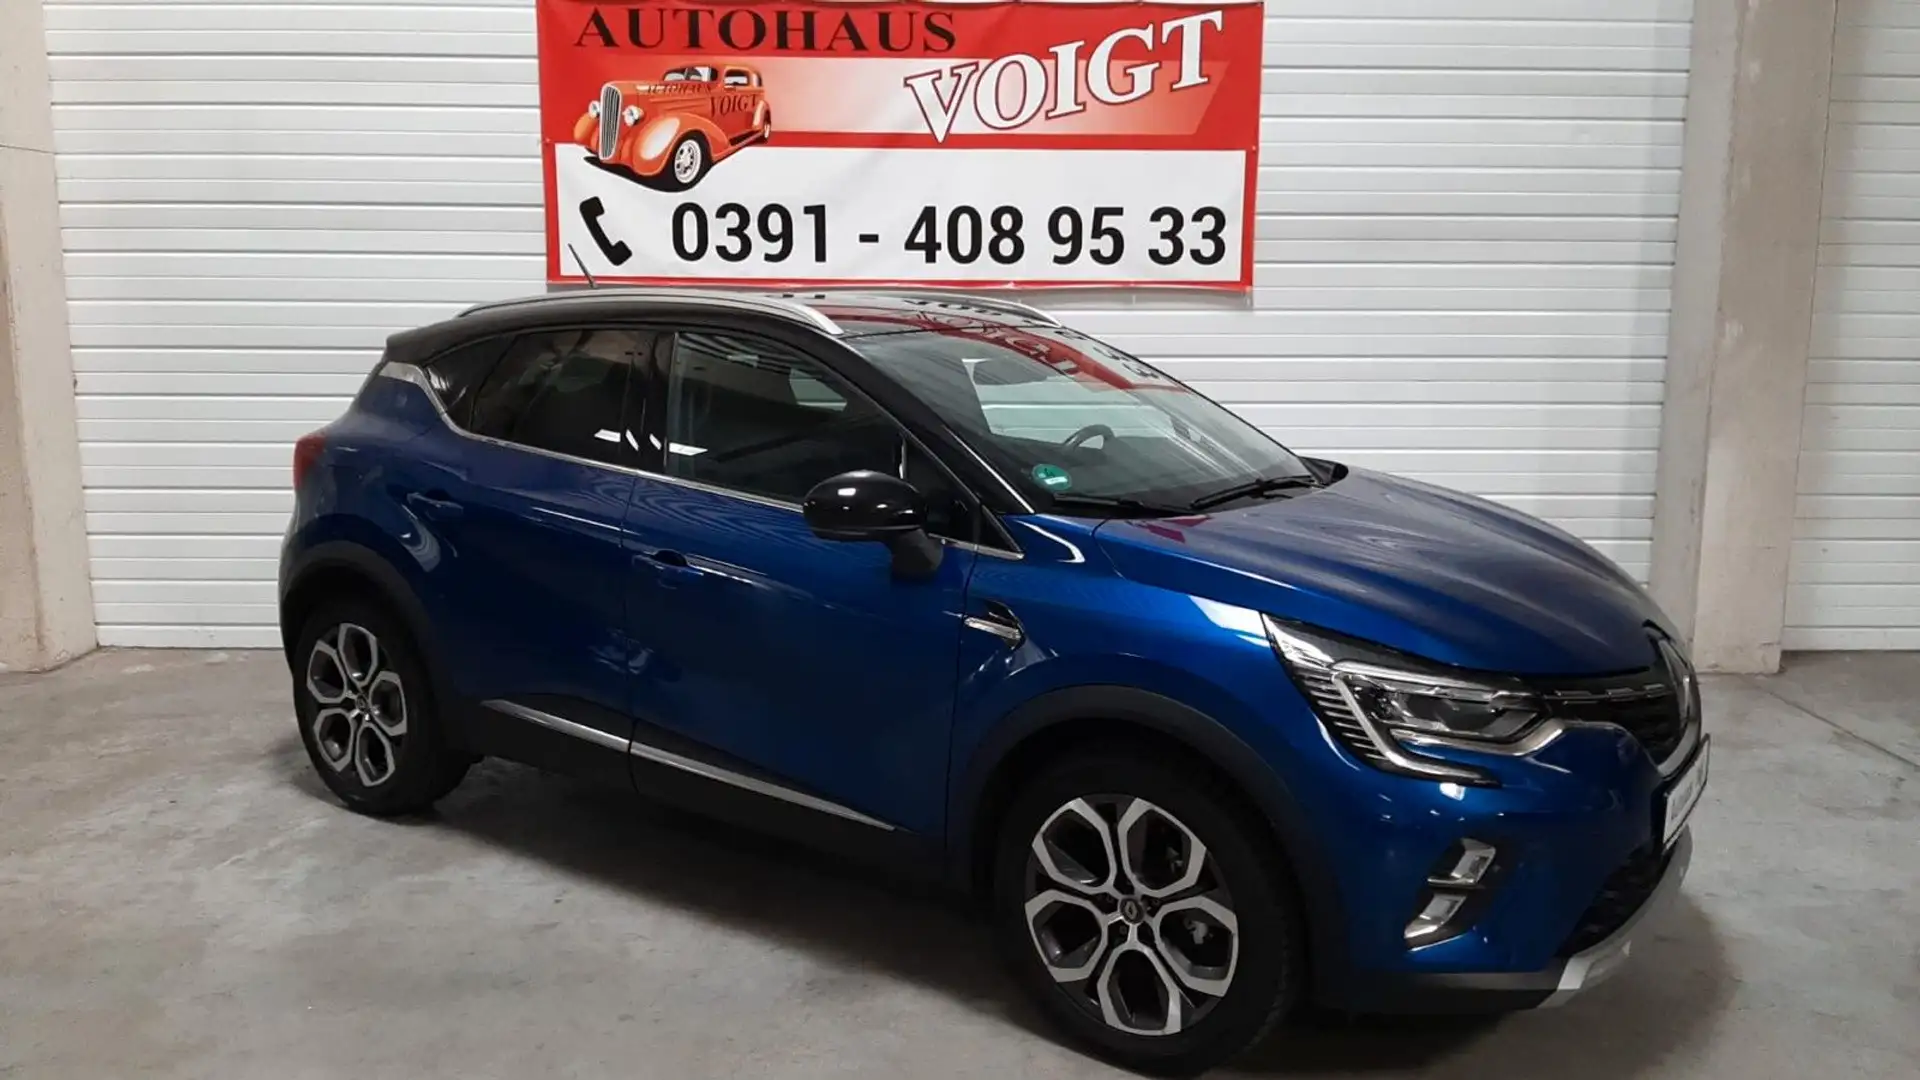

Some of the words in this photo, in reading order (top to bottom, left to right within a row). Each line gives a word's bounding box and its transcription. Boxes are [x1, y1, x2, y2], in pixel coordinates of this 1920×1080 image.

[575, 8, 956, 52] AUTOHAUS
[903, 10, 1224, 143] VOIGT
[710, 94, 758, 118] VOIGT
[672, 202, 827, 263] 0391
[859, 234, 879, 243] -
[904, 205, 1025, 265] 408
[1047, 206, 1125, 265] 95
[1148, 206, 1226, 266] 33
